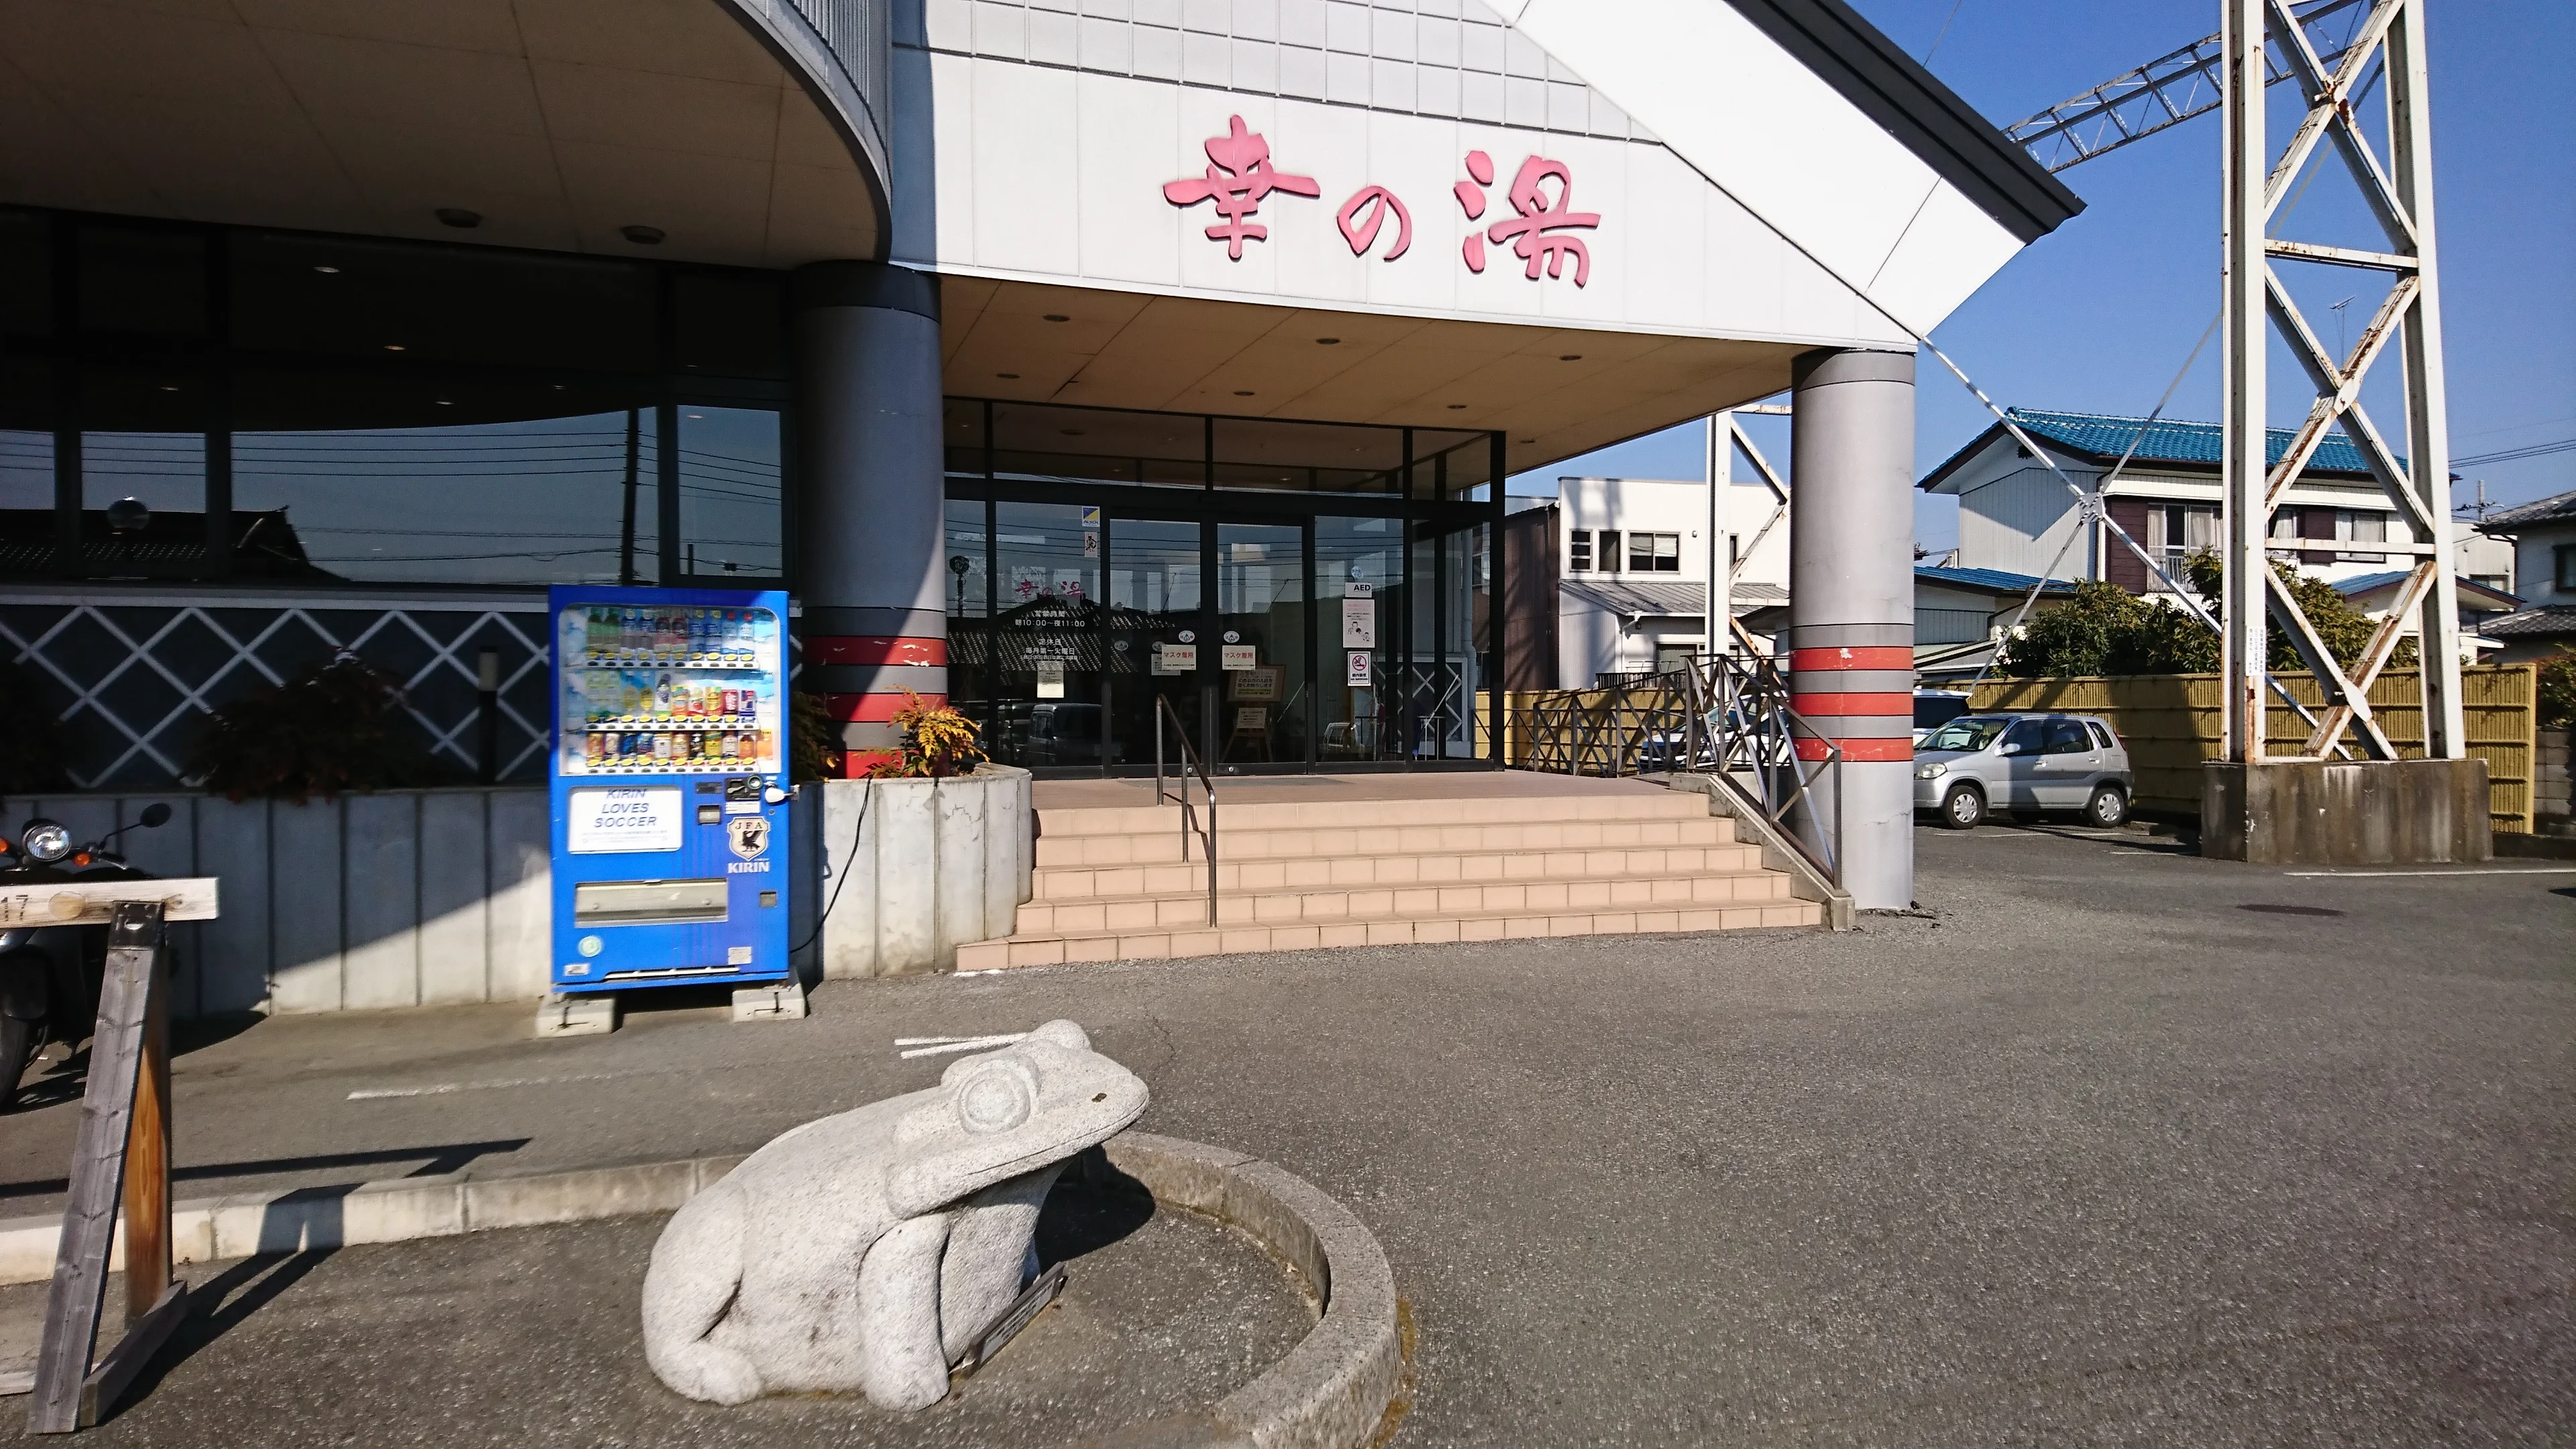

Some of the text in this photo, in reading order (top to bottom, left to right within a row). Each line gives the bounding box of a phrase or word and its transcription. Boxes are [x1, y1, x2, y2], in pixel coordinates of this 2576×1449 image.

[1034, 610, 1065, 618] 営業時間
[1026, 647, 1075, 655] 毎月第一火曜日
[606, 789, 648, 799] KIRIN
[601, 802, 650, 814] LOVES
[594, 816, 657, 828] SOCCER
[727, 861, 770, 873] KIRIN
